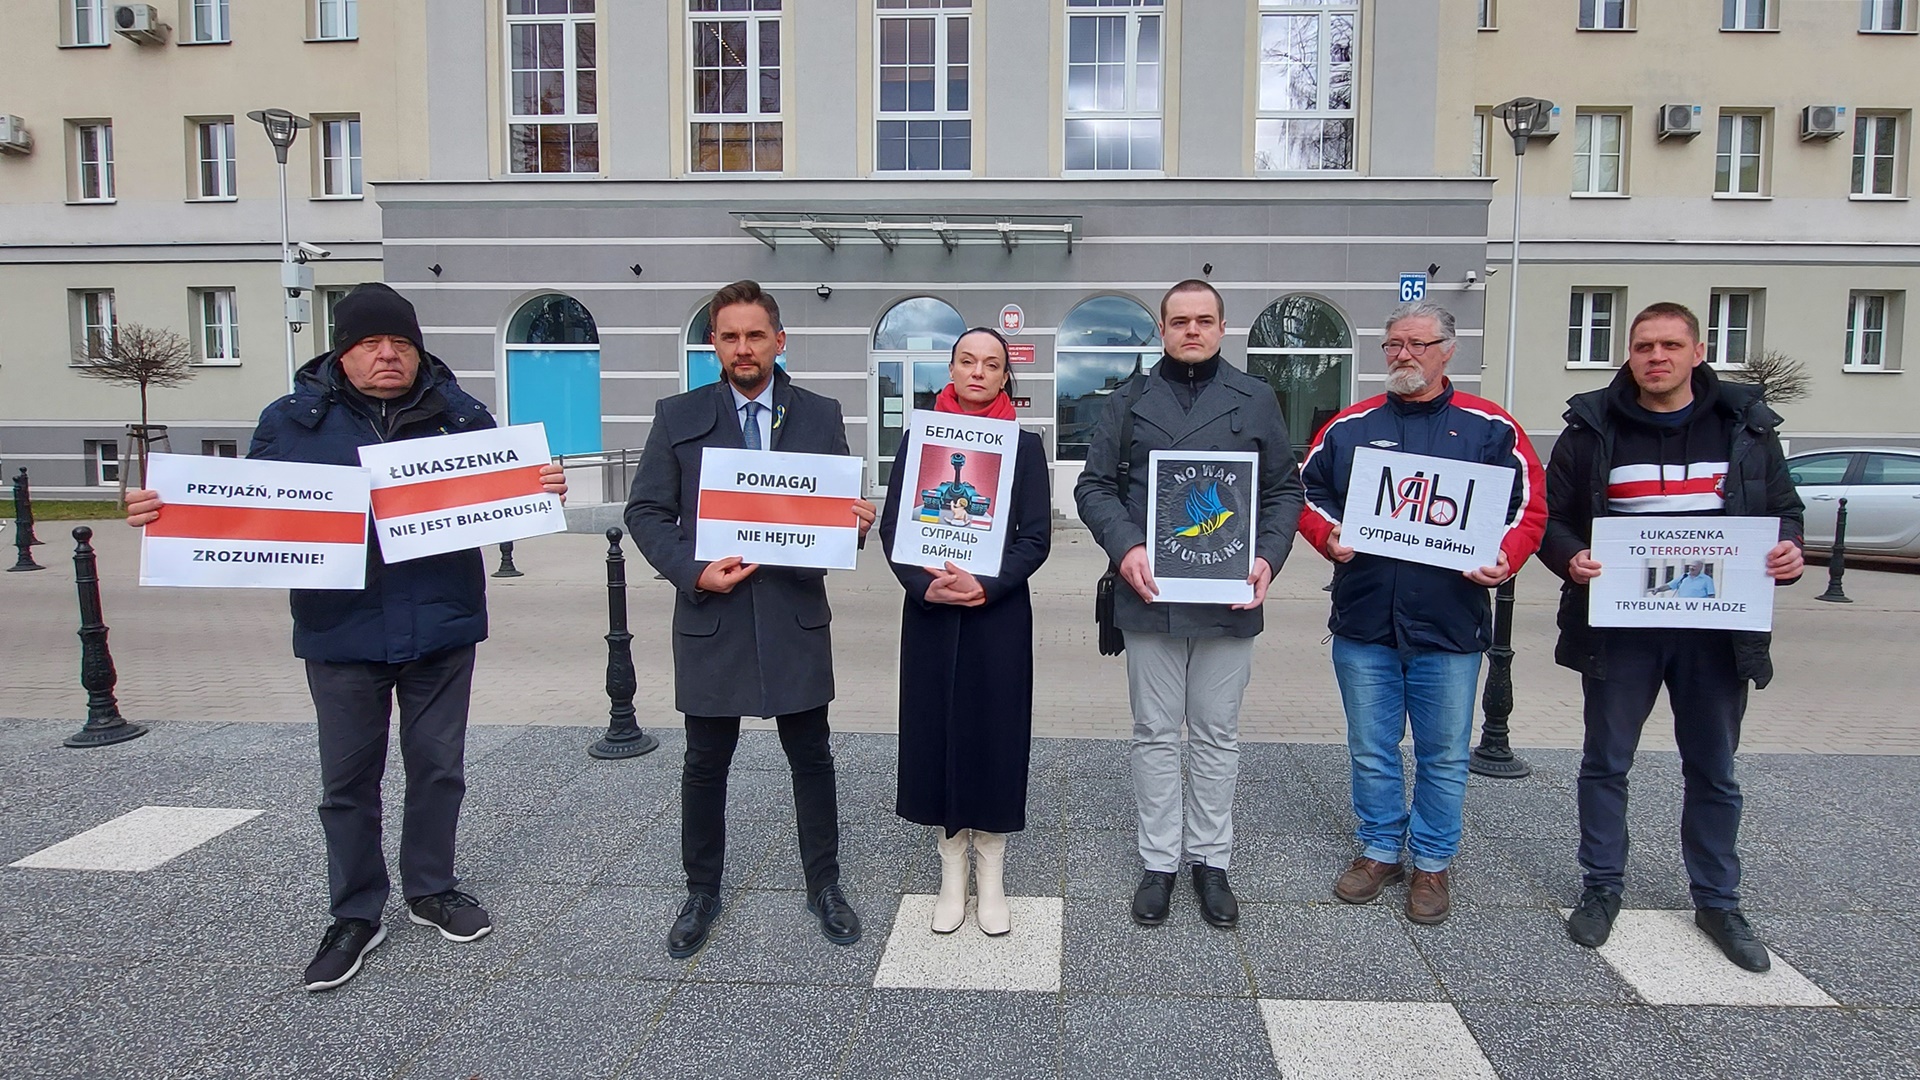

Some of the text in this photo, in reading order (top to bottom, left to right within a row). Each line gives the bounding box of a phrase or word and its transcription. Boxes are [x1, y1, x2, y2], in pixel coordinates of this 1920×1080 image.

[1401, 280, 1424, 301] 65
[925, 425, 1004, 446] БЕЛАСТОК
[389, 449, 519, 479] ŁUKASZENKA
[736, 472, 817, 492] POMAGAJ
[1173, 464, 1237, 486] NO WAR
[187, 483, 334, 501] PRZYJAŹŃ, POMOC
[389, 500, 553, 538] NIE JEST BIAŁORUSIĄ!
[737, 530, 815, 548] NIE HEJTUJ!
[921, 526, 978, 545] СУПРАЦЬ
[1359, 526, 1475, 556] супраць вайны
[1640, 530, 1725, 540] ŁUKASZENKA
[193, 550, 325, 565] ZROZUMIENIE!
[922, 544, 972, 561] ВАЙНЫ!
[1163, 536, 1244, 565] IN UKRAINE
[1629, 546, 1739, 556] TO TERRORYSTA!
[1615, 600, 1747, 613] TRYBUNAŁ W HADZE
